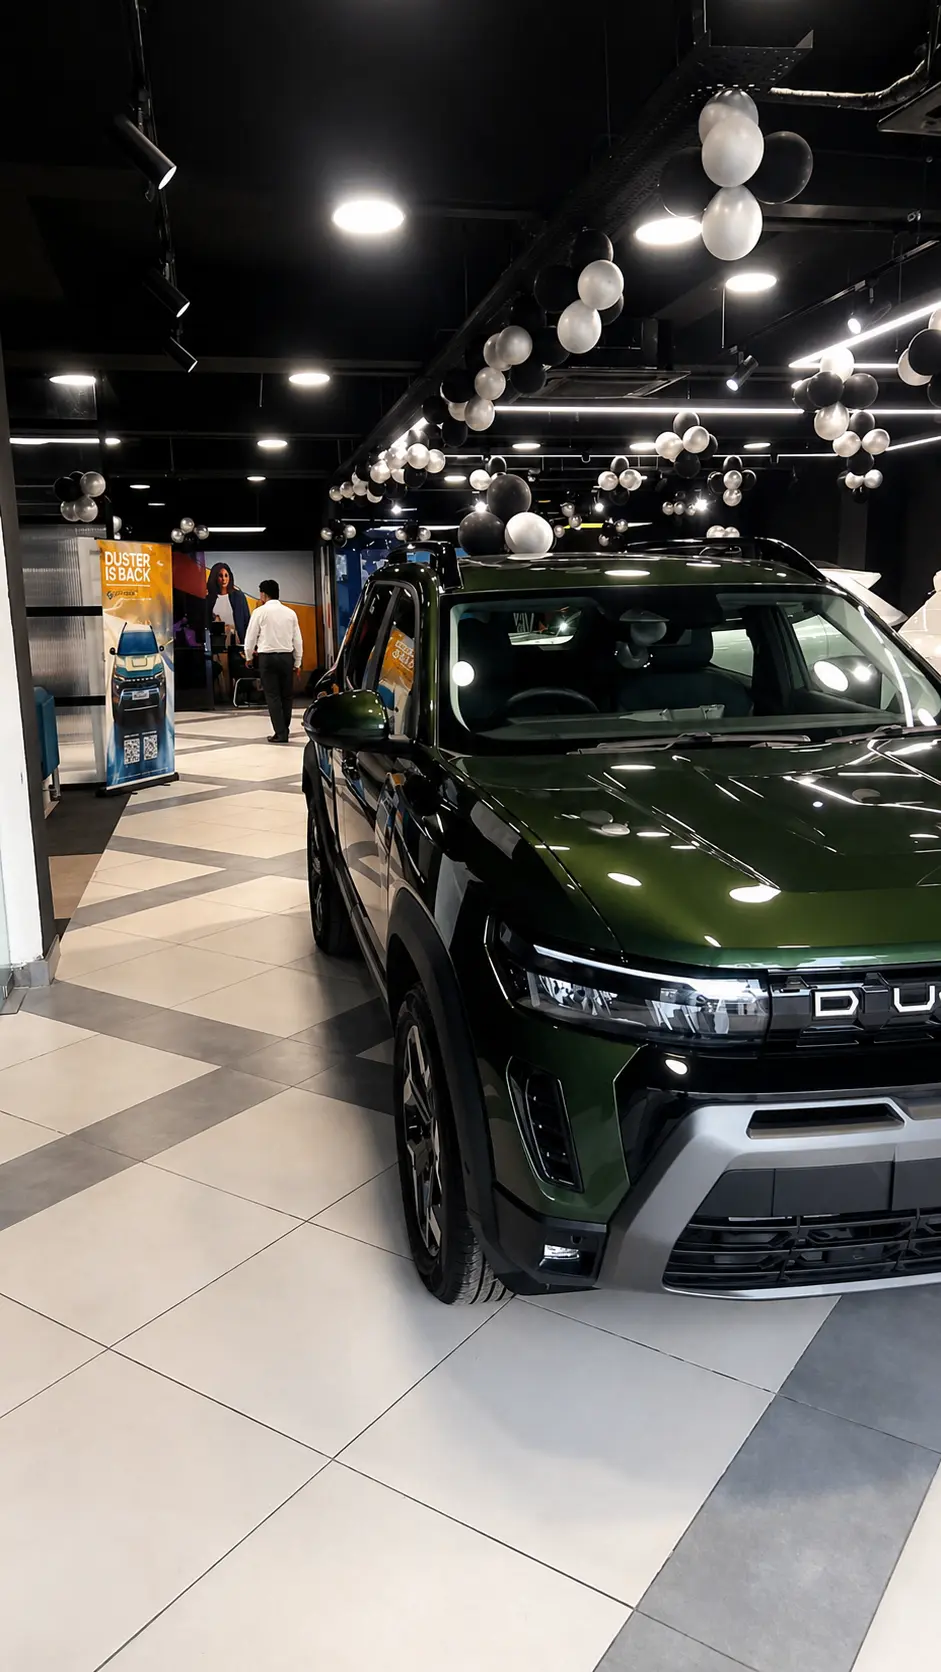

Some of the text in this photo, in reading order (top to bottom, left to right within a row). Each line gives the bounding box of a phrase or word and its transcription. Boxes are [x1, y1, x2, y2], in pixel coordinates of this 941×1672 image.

[104, 551, 151, 568] DUSTER
[105, 566, 151, 582] IS BACK
[814, 985, 941, 1017] DU
